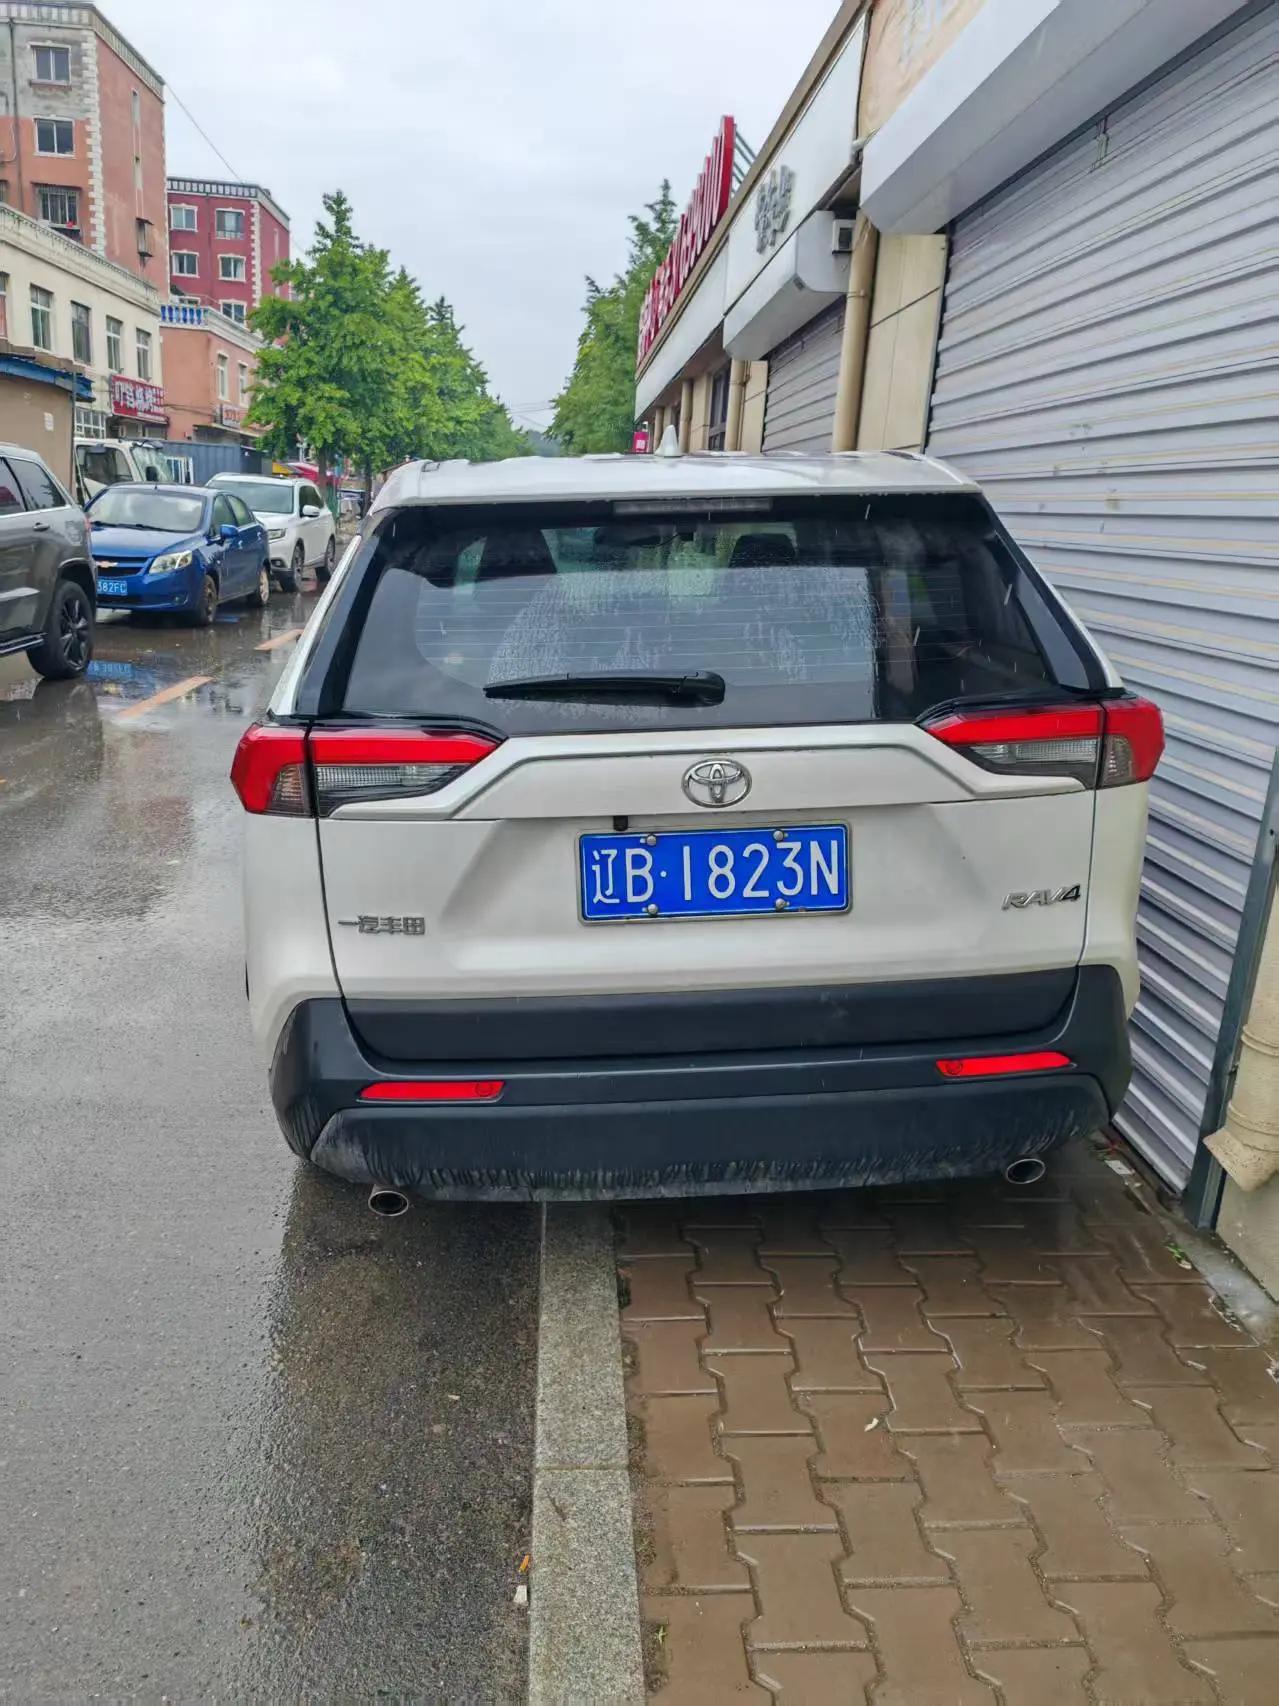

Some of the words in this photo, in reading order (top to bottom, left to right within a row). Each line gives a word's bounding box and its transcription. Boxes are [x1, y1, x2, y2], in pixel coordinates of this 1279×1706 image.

[1001, 884, 1081, 911] RAV4
[338, 916, 425, 935] 一汽丰田
